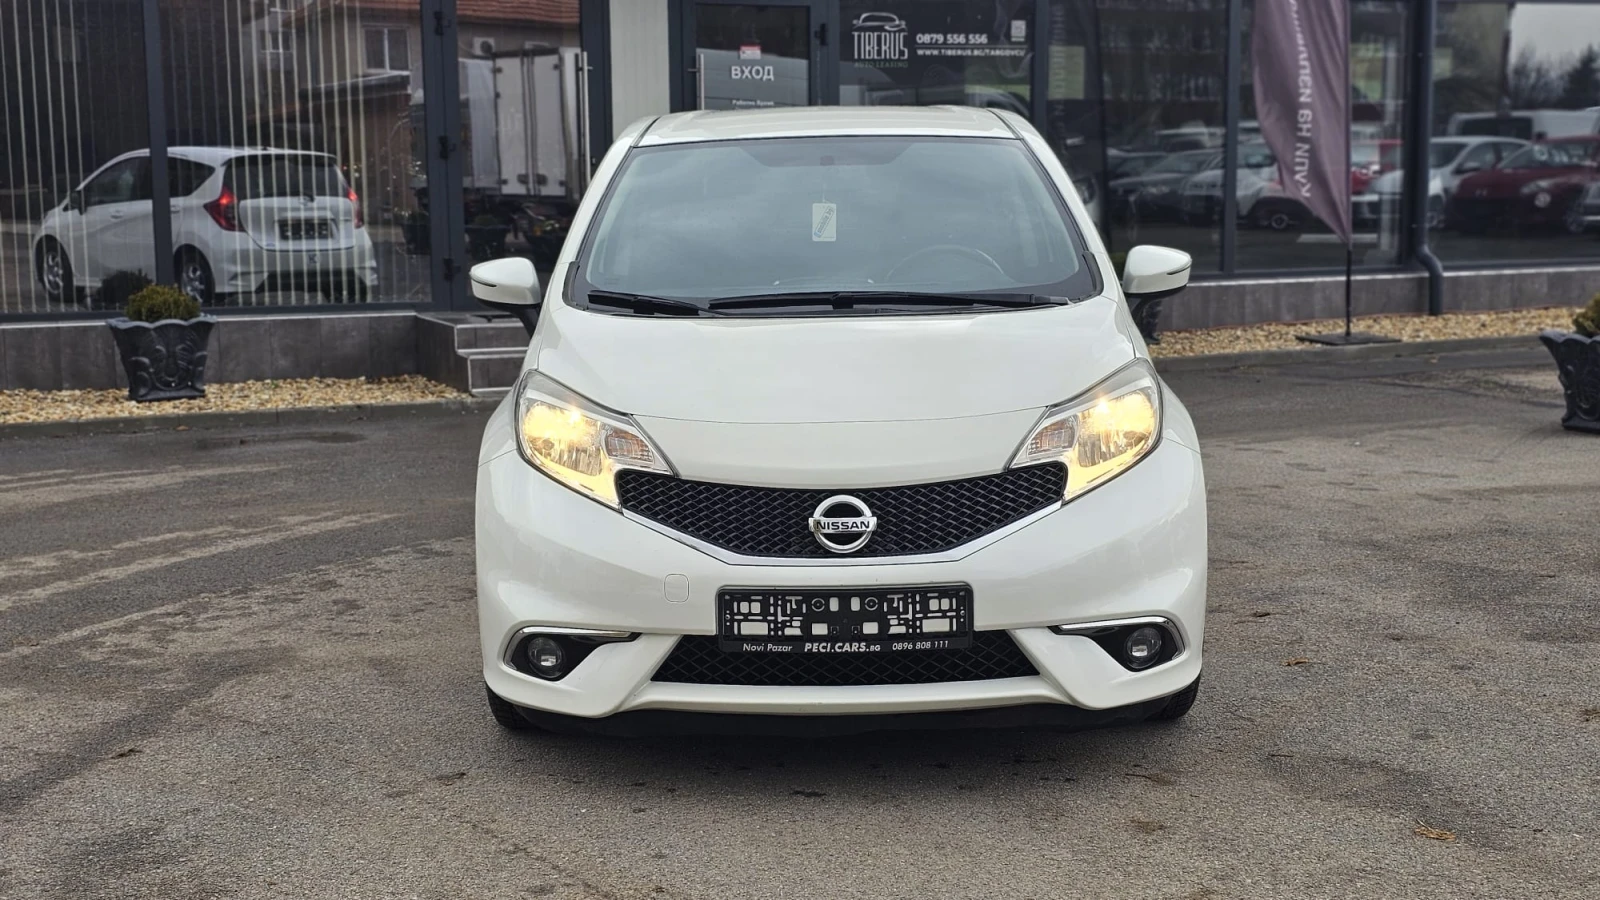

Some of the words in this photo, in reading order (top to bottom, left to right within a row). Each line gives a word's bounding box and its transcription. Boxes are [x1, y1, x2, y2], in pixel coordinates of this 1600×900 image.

[916, 34, 944, 44] 0879
[946, 34, 966, 44] 556
[968, 34, 988, 44] 556
[851, 31, 908, 60] TIBERUS
[731, 65, 774, 81] ВХОД
[816, 520, 870, 531] NISSAN
[743, 643, 764, 651] Novi
[767, 643, 793, 652] Pazar
[892, 642, 913, 651] 0896
[915, 641, 931, 650] 808
[934, 640, 949, 649] 111
